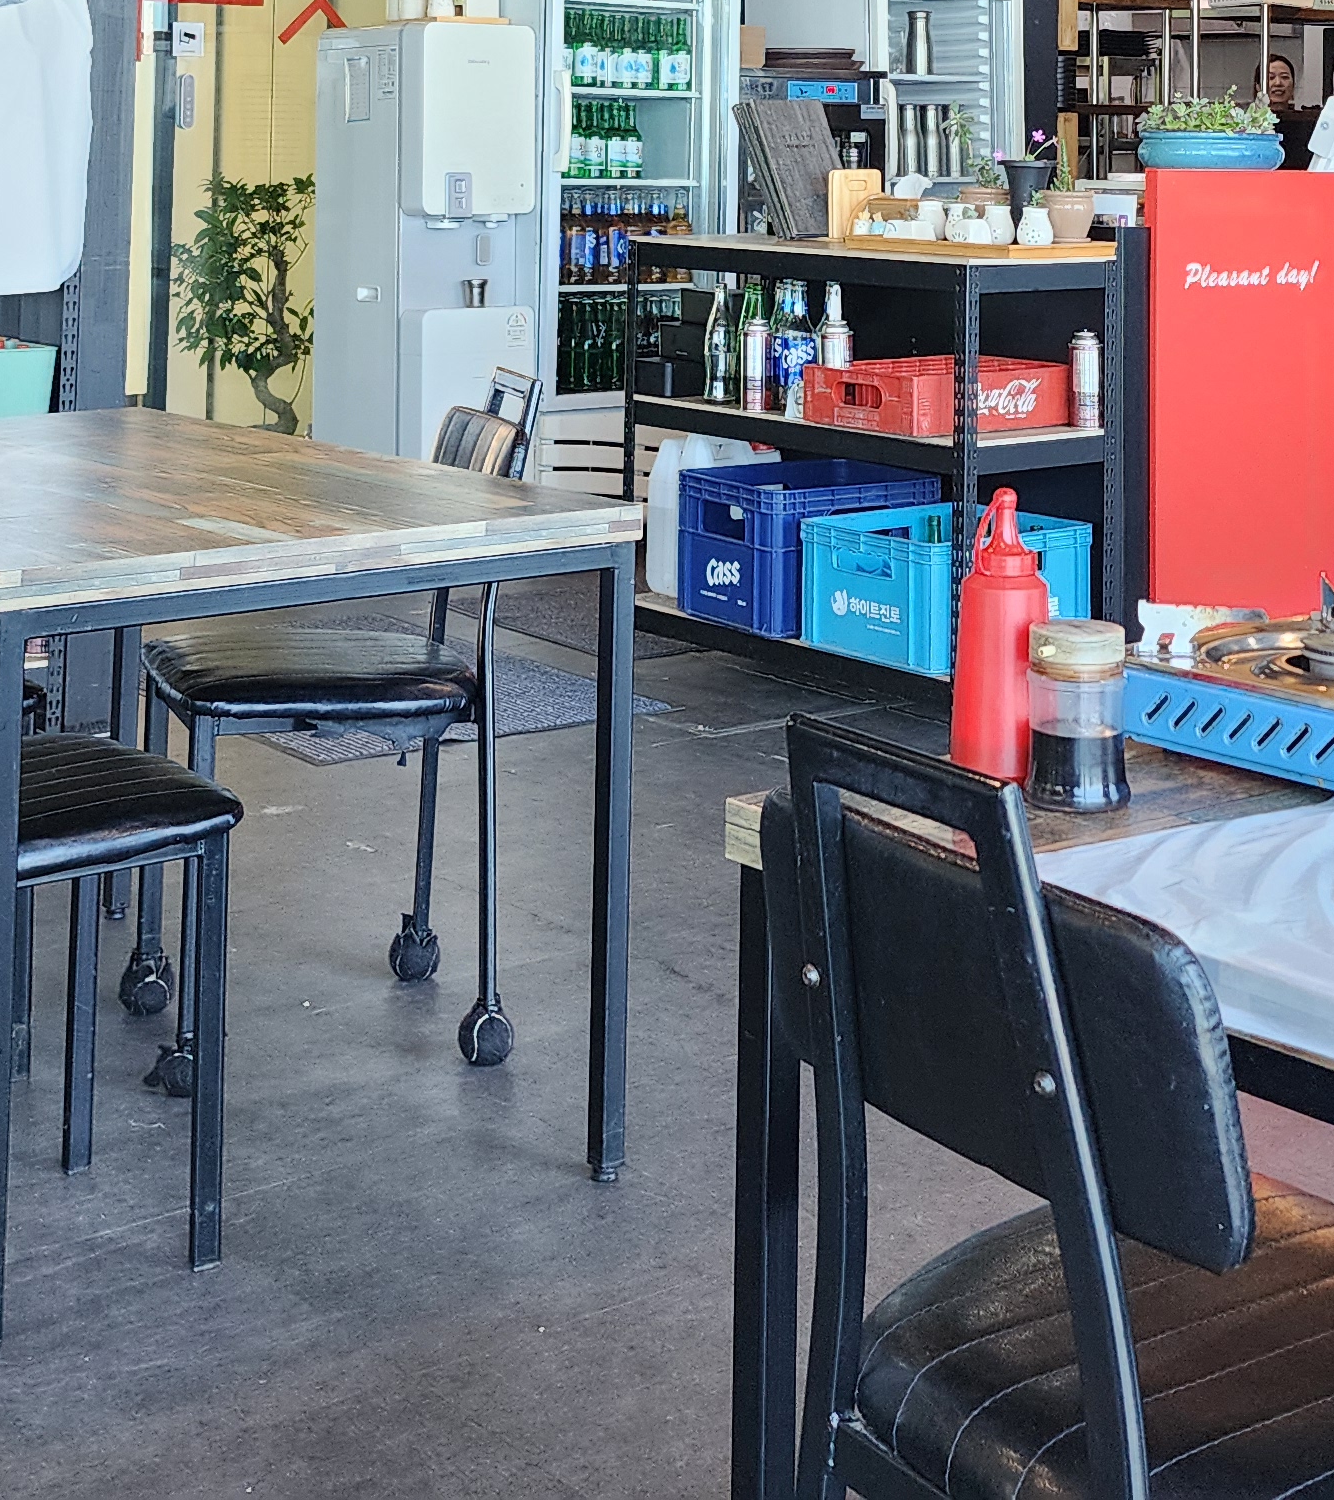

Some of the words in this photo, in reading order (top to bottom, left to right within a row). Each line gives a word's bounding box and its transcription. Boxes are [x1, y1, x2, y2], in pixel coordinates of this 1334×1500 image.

[1184, 261, 1271, 291] Pleasant
[1276, 259, 1320, 292] day!
[706, 558, 741, 587] Cass
[849, 596, 901, 624] 하이트진로
